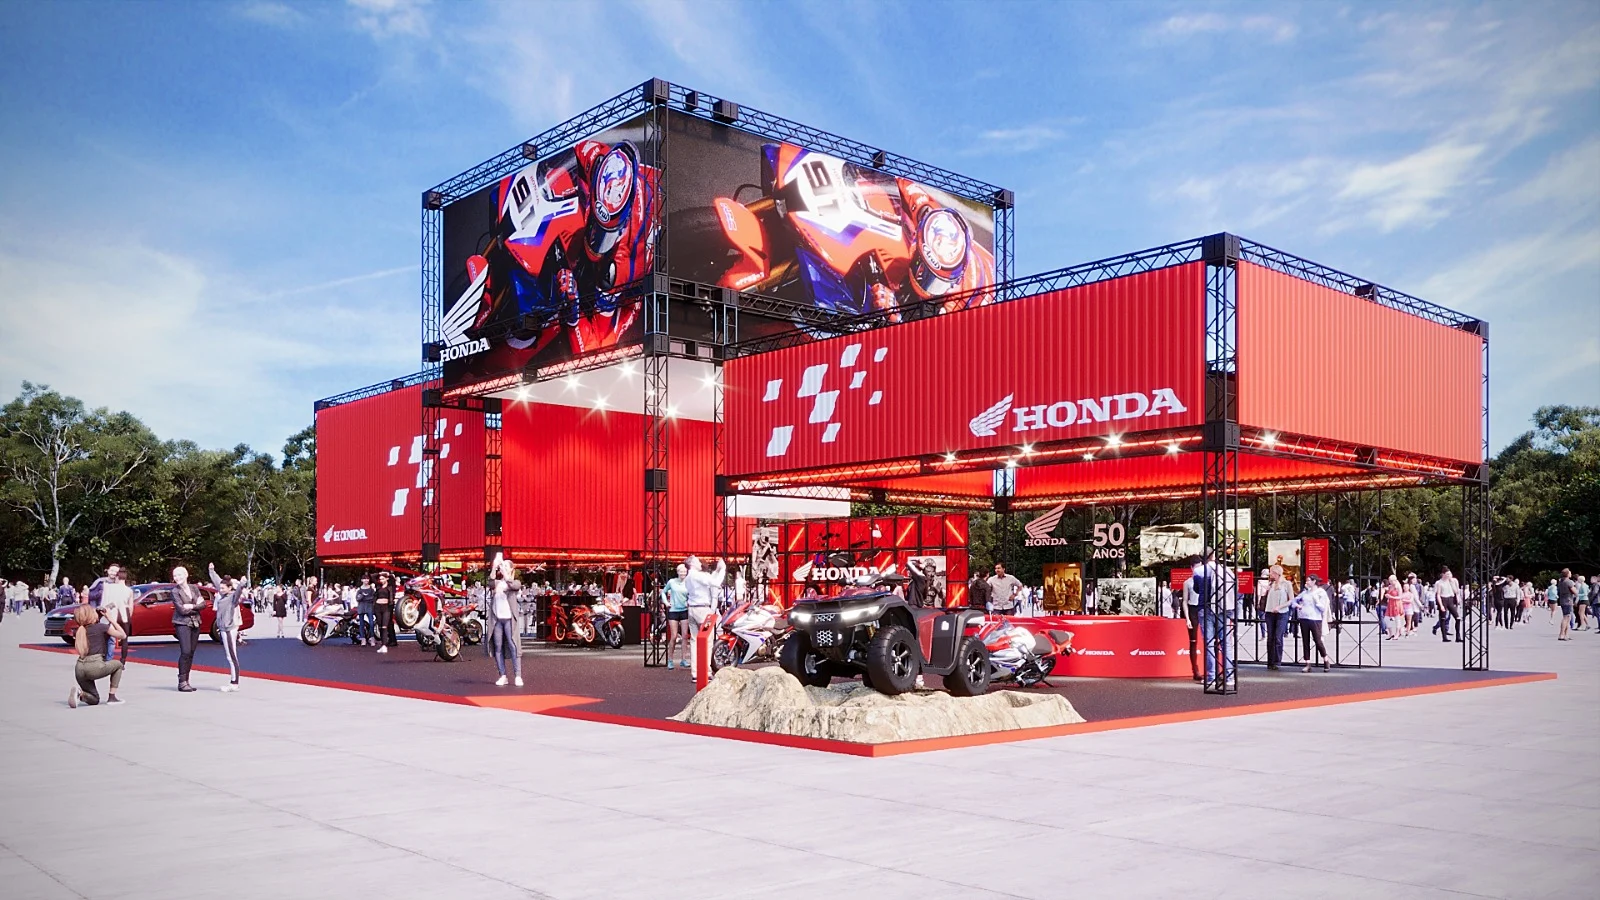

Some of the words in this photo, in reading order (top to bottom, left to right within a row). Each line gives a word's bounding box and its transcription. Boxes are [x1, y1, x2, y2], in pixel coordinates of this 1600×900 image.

[440, 337, 491, 362] HONDA
[1012, 388, 1187, 432] HONDA
[334, 528, 368, 541] HONDA
[1025, 537, 1068, 547] HONDA
[1092, 522, 1125, 547] 50
